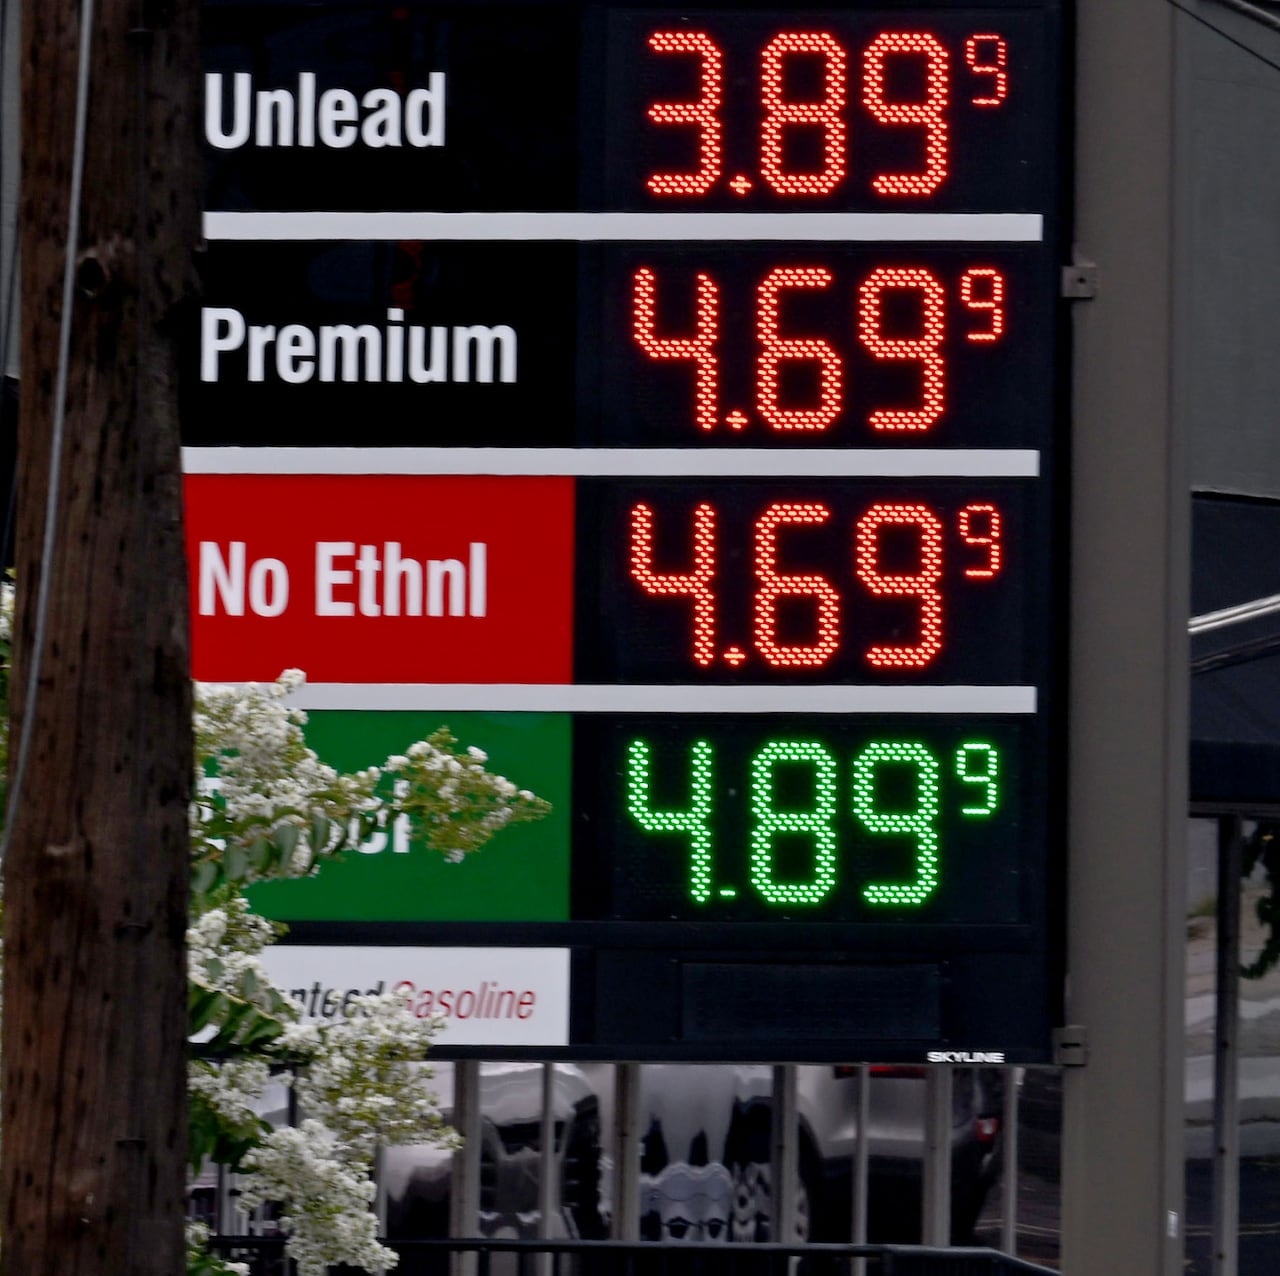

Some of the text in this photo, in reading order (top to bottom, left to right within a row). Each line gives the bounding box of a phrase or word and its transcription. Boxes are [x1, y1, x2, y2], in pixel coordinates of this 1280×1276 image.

[204, 72, 446, 149] Unlead
[201, 308, 517, 384] Premium
[199, 541, 289, 618] No
[315, 541, 487, 618] Ethnl
[926, 1051, 1006, 1063] SKYLINE
